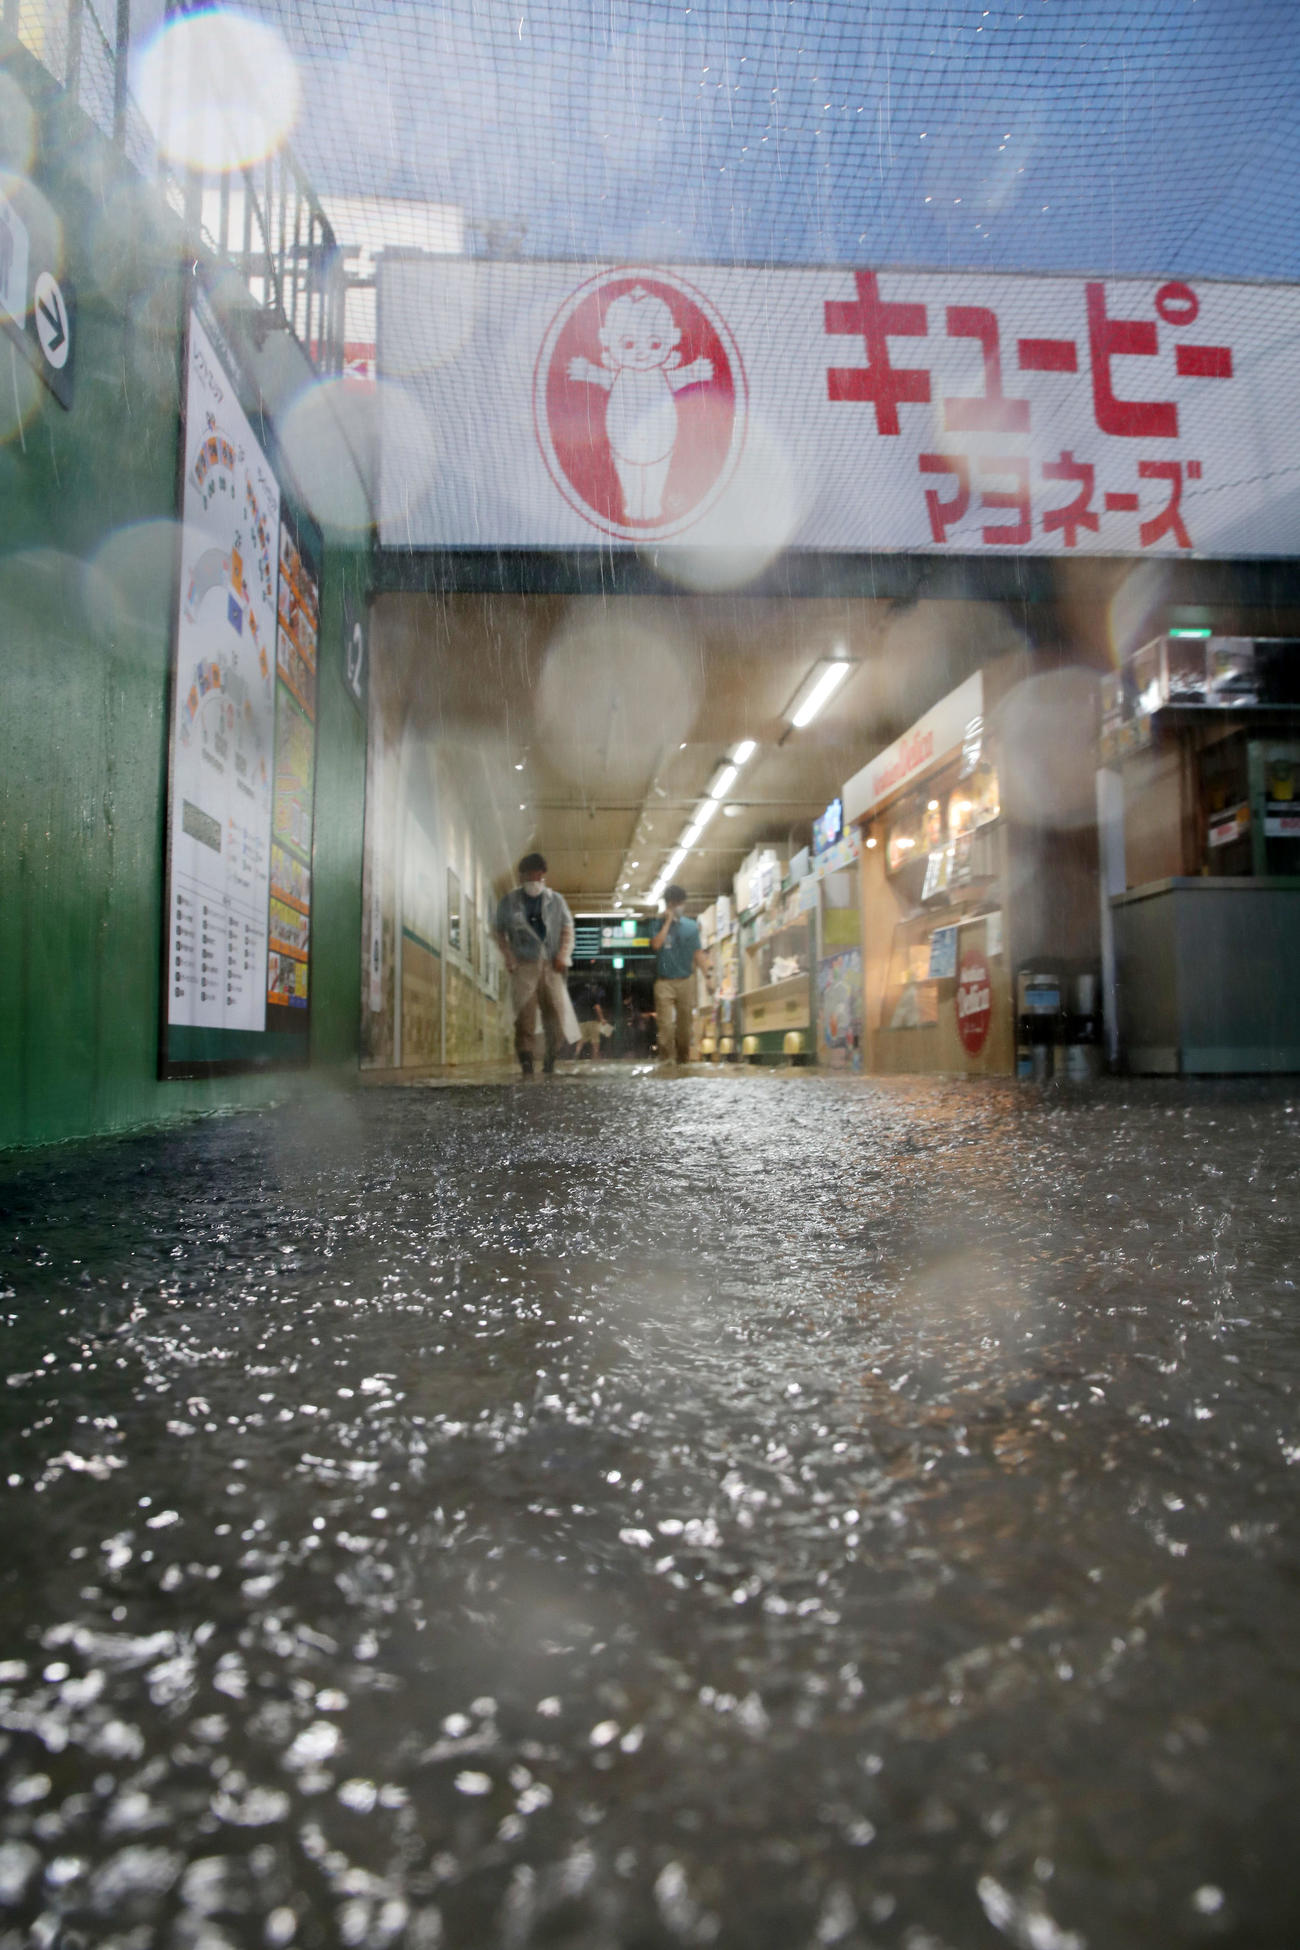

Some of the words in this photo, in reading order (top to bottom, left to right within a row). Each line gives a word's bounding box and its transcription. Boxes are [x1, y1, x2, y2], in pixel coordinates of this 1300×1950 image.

[824, 271, 1233, 438] キューピー
[918, 451, 1203, 549] マヨネーズ
